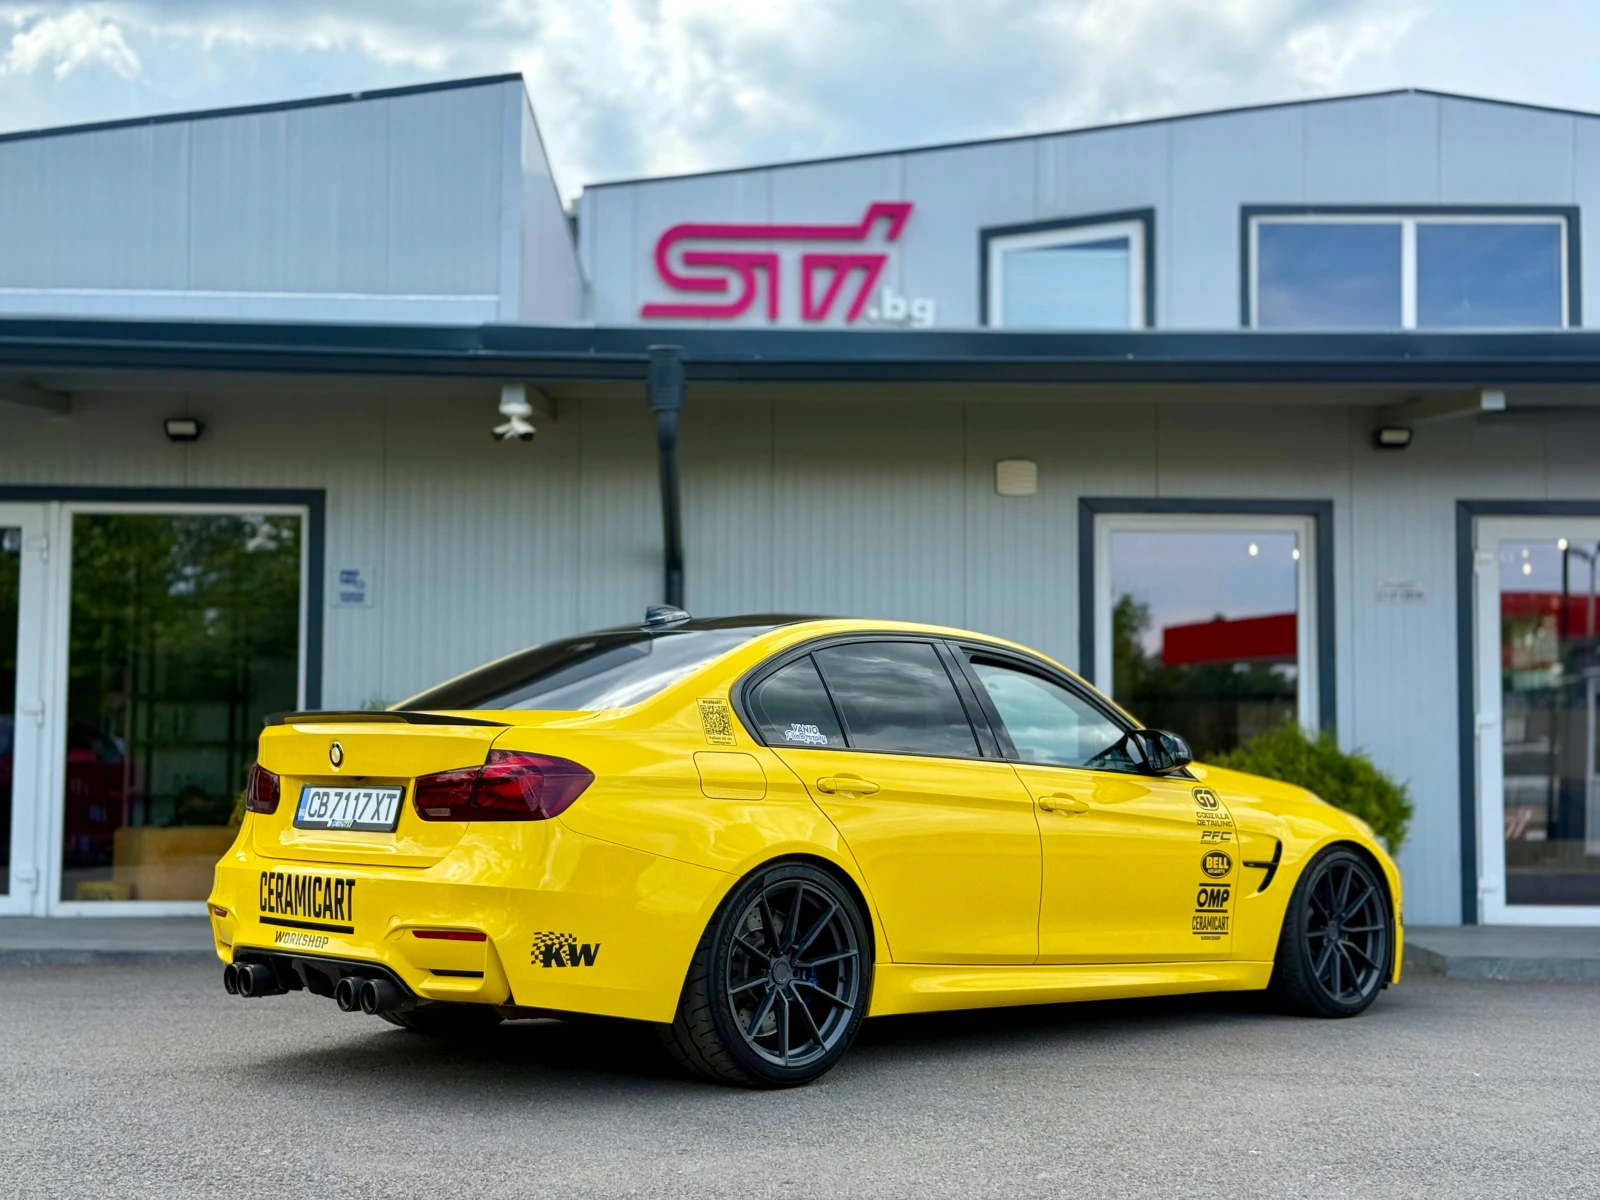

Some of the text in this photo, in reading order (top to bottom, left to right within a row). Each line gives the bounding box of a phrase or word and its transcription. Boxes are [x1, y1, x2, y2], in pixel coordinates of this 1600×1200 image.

[791, 723, 818, 735] VANIO
[1196, 812, 1230, 820] GODZILLA
[1196, 819, 1233, 828] DETAILING
[1201, 830, 1232, 841] PFC
[1206, 856, 1229, 869] BELL
[259, 871, 356, 922] CERAMICART
[1196, 888, 1230, 908] OMP
[1192, 915, 1229, 930] CERAMICART
[274, 930, 329, 949] WORKSHOP
[541, 942, 601, 968] KW
